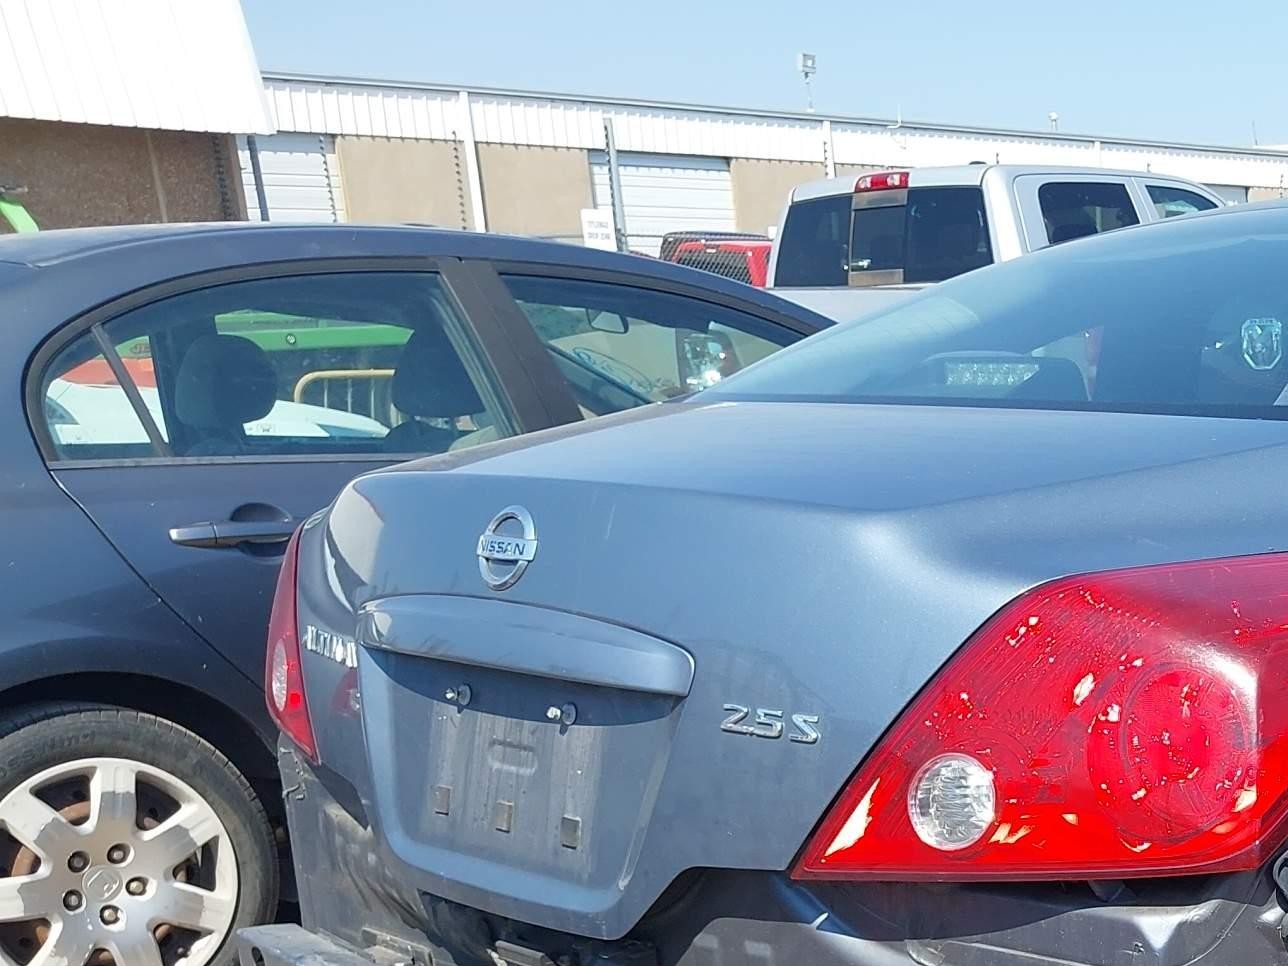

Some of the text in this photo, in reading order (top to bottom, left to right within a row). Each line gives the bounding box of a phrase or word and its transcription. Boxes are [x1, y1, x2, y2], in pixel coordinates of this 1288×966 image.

[480, 538, 526, 556] NISSAN
[720, 703, 821, 745] 2.5 S
